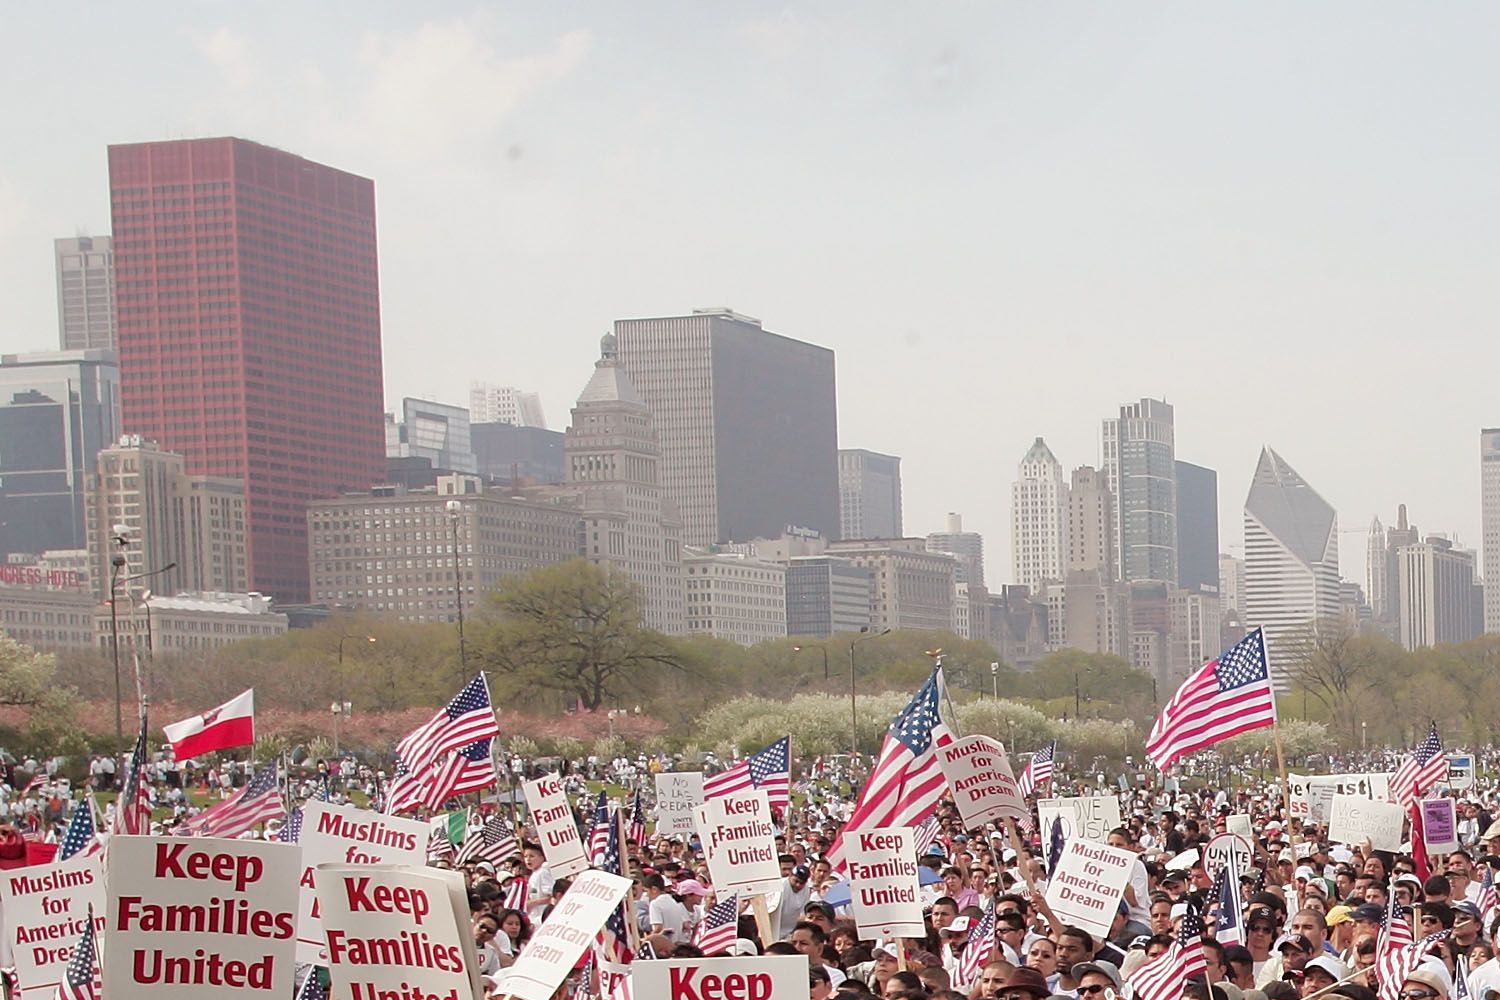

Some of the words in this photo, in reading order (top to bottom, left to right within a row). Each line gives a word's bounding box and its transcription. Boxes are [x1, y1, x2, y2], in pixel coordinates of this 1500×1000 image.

[945, 740, 1002, 763] Muslims
[970, 756, 993, 769] for
[537, 779, 563, 798] Kee
[954, 769, 1017, 792] American
[968, 783, 1016, 802] Dream
[533, 800, 570, 826] Fami
[724, 798, 760, 816] Keep
[317, 812, 417, 851] Muslims
[547, 824, 579, 847] Unit
[717, 820, 773, 842] Families
[727, 844, 773, 865] United
[860, 833, 903, 854] Keep
[1071, 843, 1128, 868] Muslims
[1208, 848, 1249, 863] UNTE
[155, 843, 263, 892] Keep
[849, 858, 917, 880] Families
[1083, 861, 1104, 877] for
[10, 869, 93, 896] Muslims
[1056, 871, 1120, 899] American
[42, 896, 71, 915] for
[344, 877, 430, 925] Keep
[860, 884, 915, 906] United
[1060, 887, 1105, 911] Dream
[117, 896, 294, 940] Families
[16, 916, 106, 945] Americn
[33, 945, 76, 966] Drea
[326, 929, 464, 973] Families
[133, 949, 274, 990] United
[600, 969, 625, 995] ep
